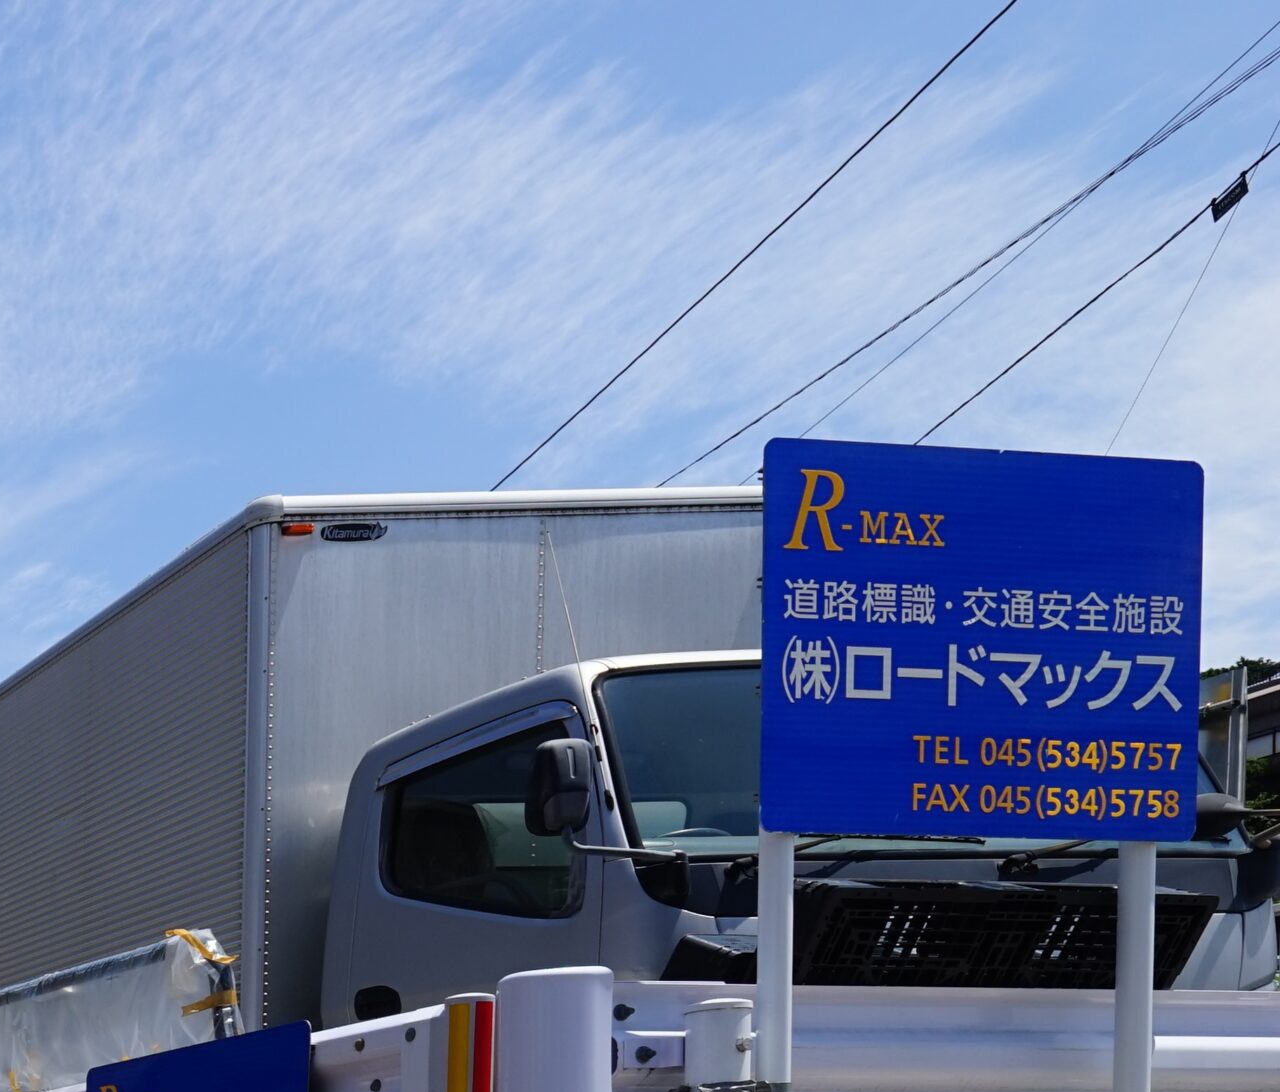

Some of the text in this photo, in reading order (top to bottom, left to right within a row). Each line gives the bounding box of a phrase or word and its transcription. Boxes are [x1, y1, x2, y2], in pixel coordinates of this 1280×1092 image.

[782, 468, 945, 551] R-MAX
[323, 526, 369, 539] Kitamura
[783, 578, 1184, 636] 道路標識・交通安全施設
[912, 735, 1182, 774] TEL 045(534)5757
[911, 783, 1180, 820] FAX 045(534)5758
